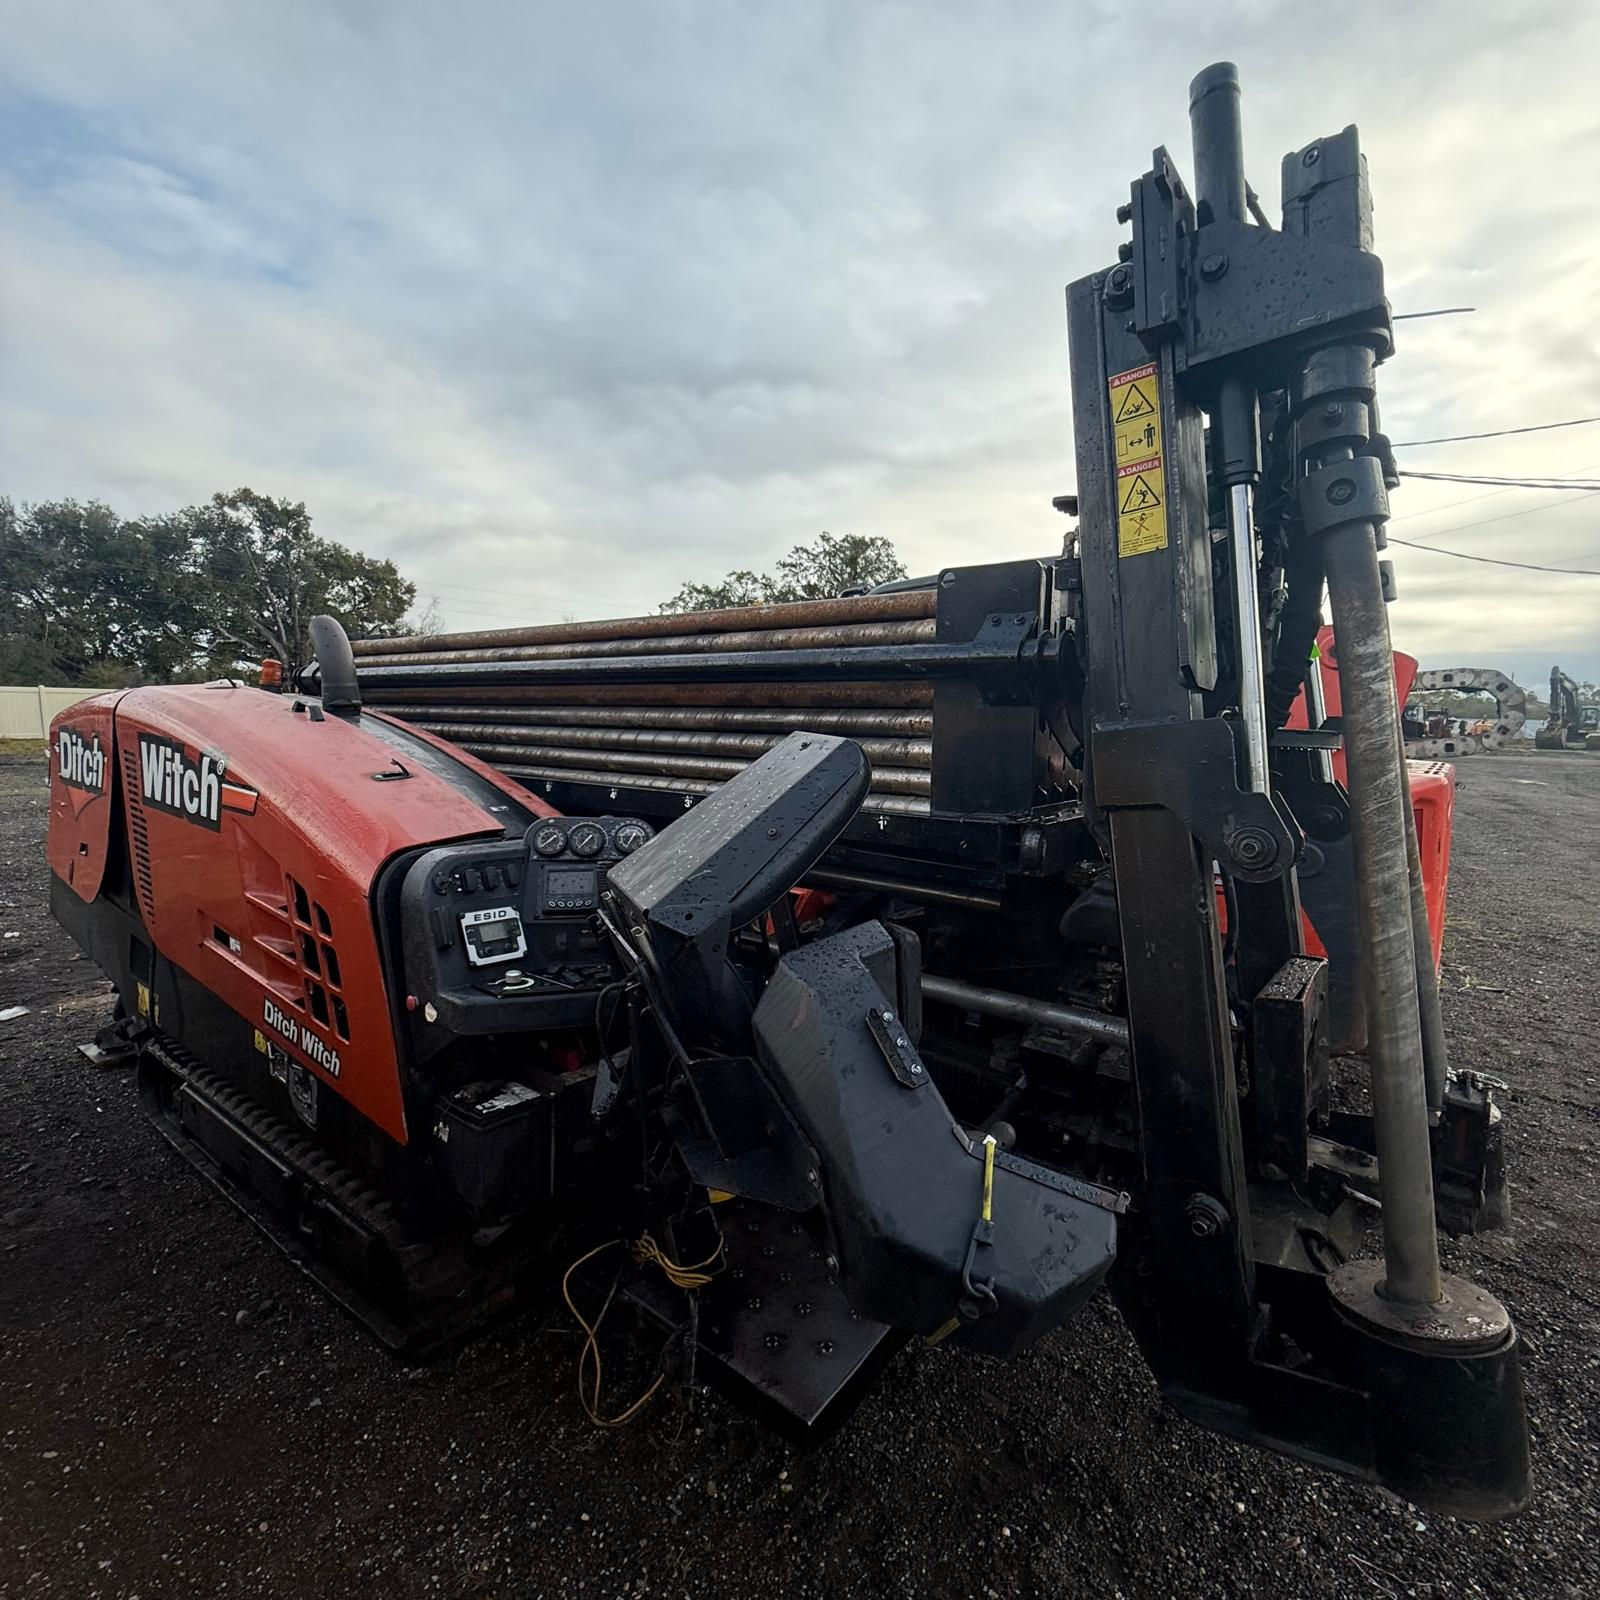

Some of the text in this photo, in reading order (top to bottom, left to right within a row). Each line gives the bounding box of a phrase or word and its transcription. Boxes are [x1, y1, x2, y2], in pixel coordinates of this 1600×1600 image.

[1120, 367, 1154, 384] DANGER
[1127, 460, 1159, 475] DANGER
[59, 731, 104, 789] Ditch
[473, 910, 507, 922] ESID
[264, 999, 341, 1076] Ditch Witch
